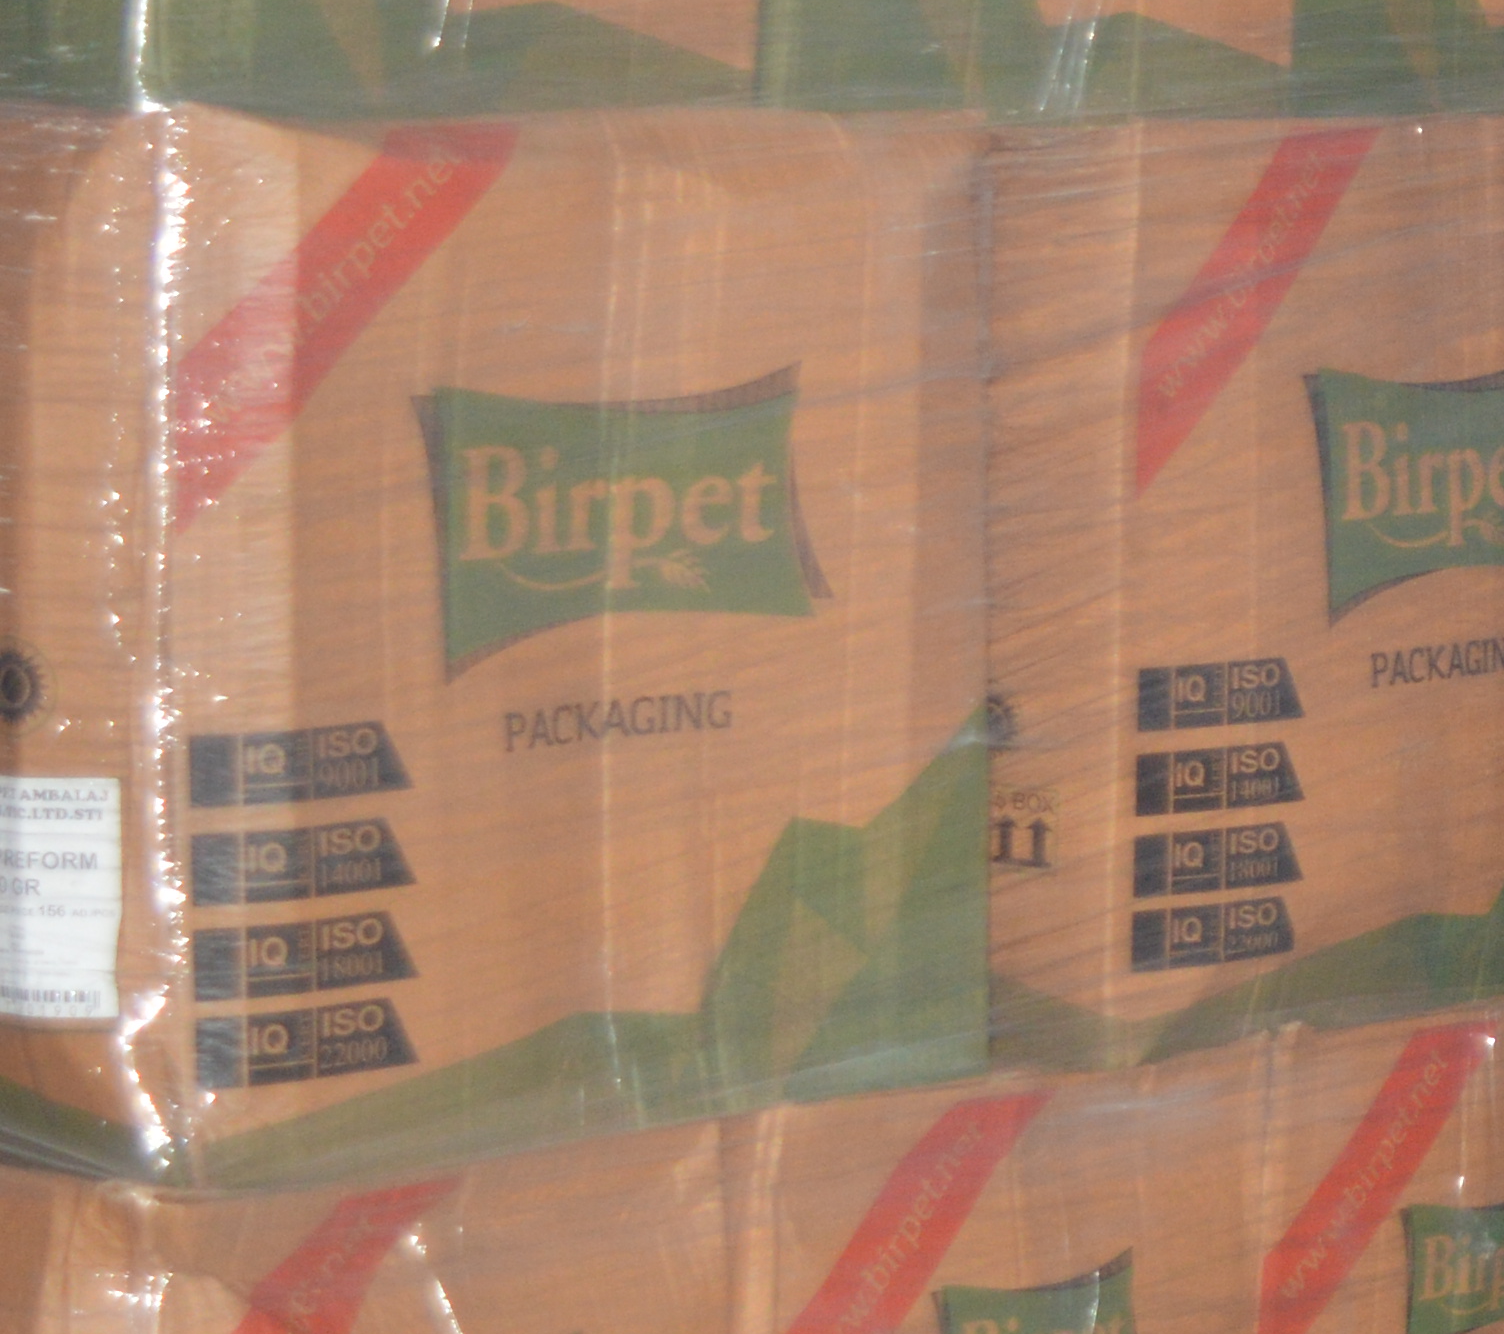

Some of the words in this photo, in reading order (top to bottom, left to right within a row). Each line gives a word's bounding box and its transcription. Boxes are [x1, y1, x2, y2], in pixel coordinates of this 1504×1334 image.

[458, 445, 776, 590] Birpet
[1176, 675, 1206, 702] IQ
[1232, 664, 1280, 689] ISO
[1232, 688, 1280, 717] 9001
[505, 690, 732, 752] PACKAGING
[247, 743, 287, 774] IQ
[320, 727, 378, 758] ISO
[1175, 761, 1205, 787] IQ
[1232, 748, 1280, 774] ISO
[20, 789, 109, 802] AMBALAJ
[248, 842, 288, 872] IQ
[320, 825, 381, 856] ISO
[1175, 841, 1204, 868] IQ
[1230, 828, 1279, 854] ISO
[12, 878, 40, 896] GR
[39, 905, 65, 917] 156
[1174, 916, 1202, 943] IQ
[1229, 902, 1277, 930] ISO
[250, 936, 288, 967] IQ
[321, 917, 383, 951] ISO
[252, 1024, 289, 1055] IQ
[322, 1005, 385, 1037] ISO
